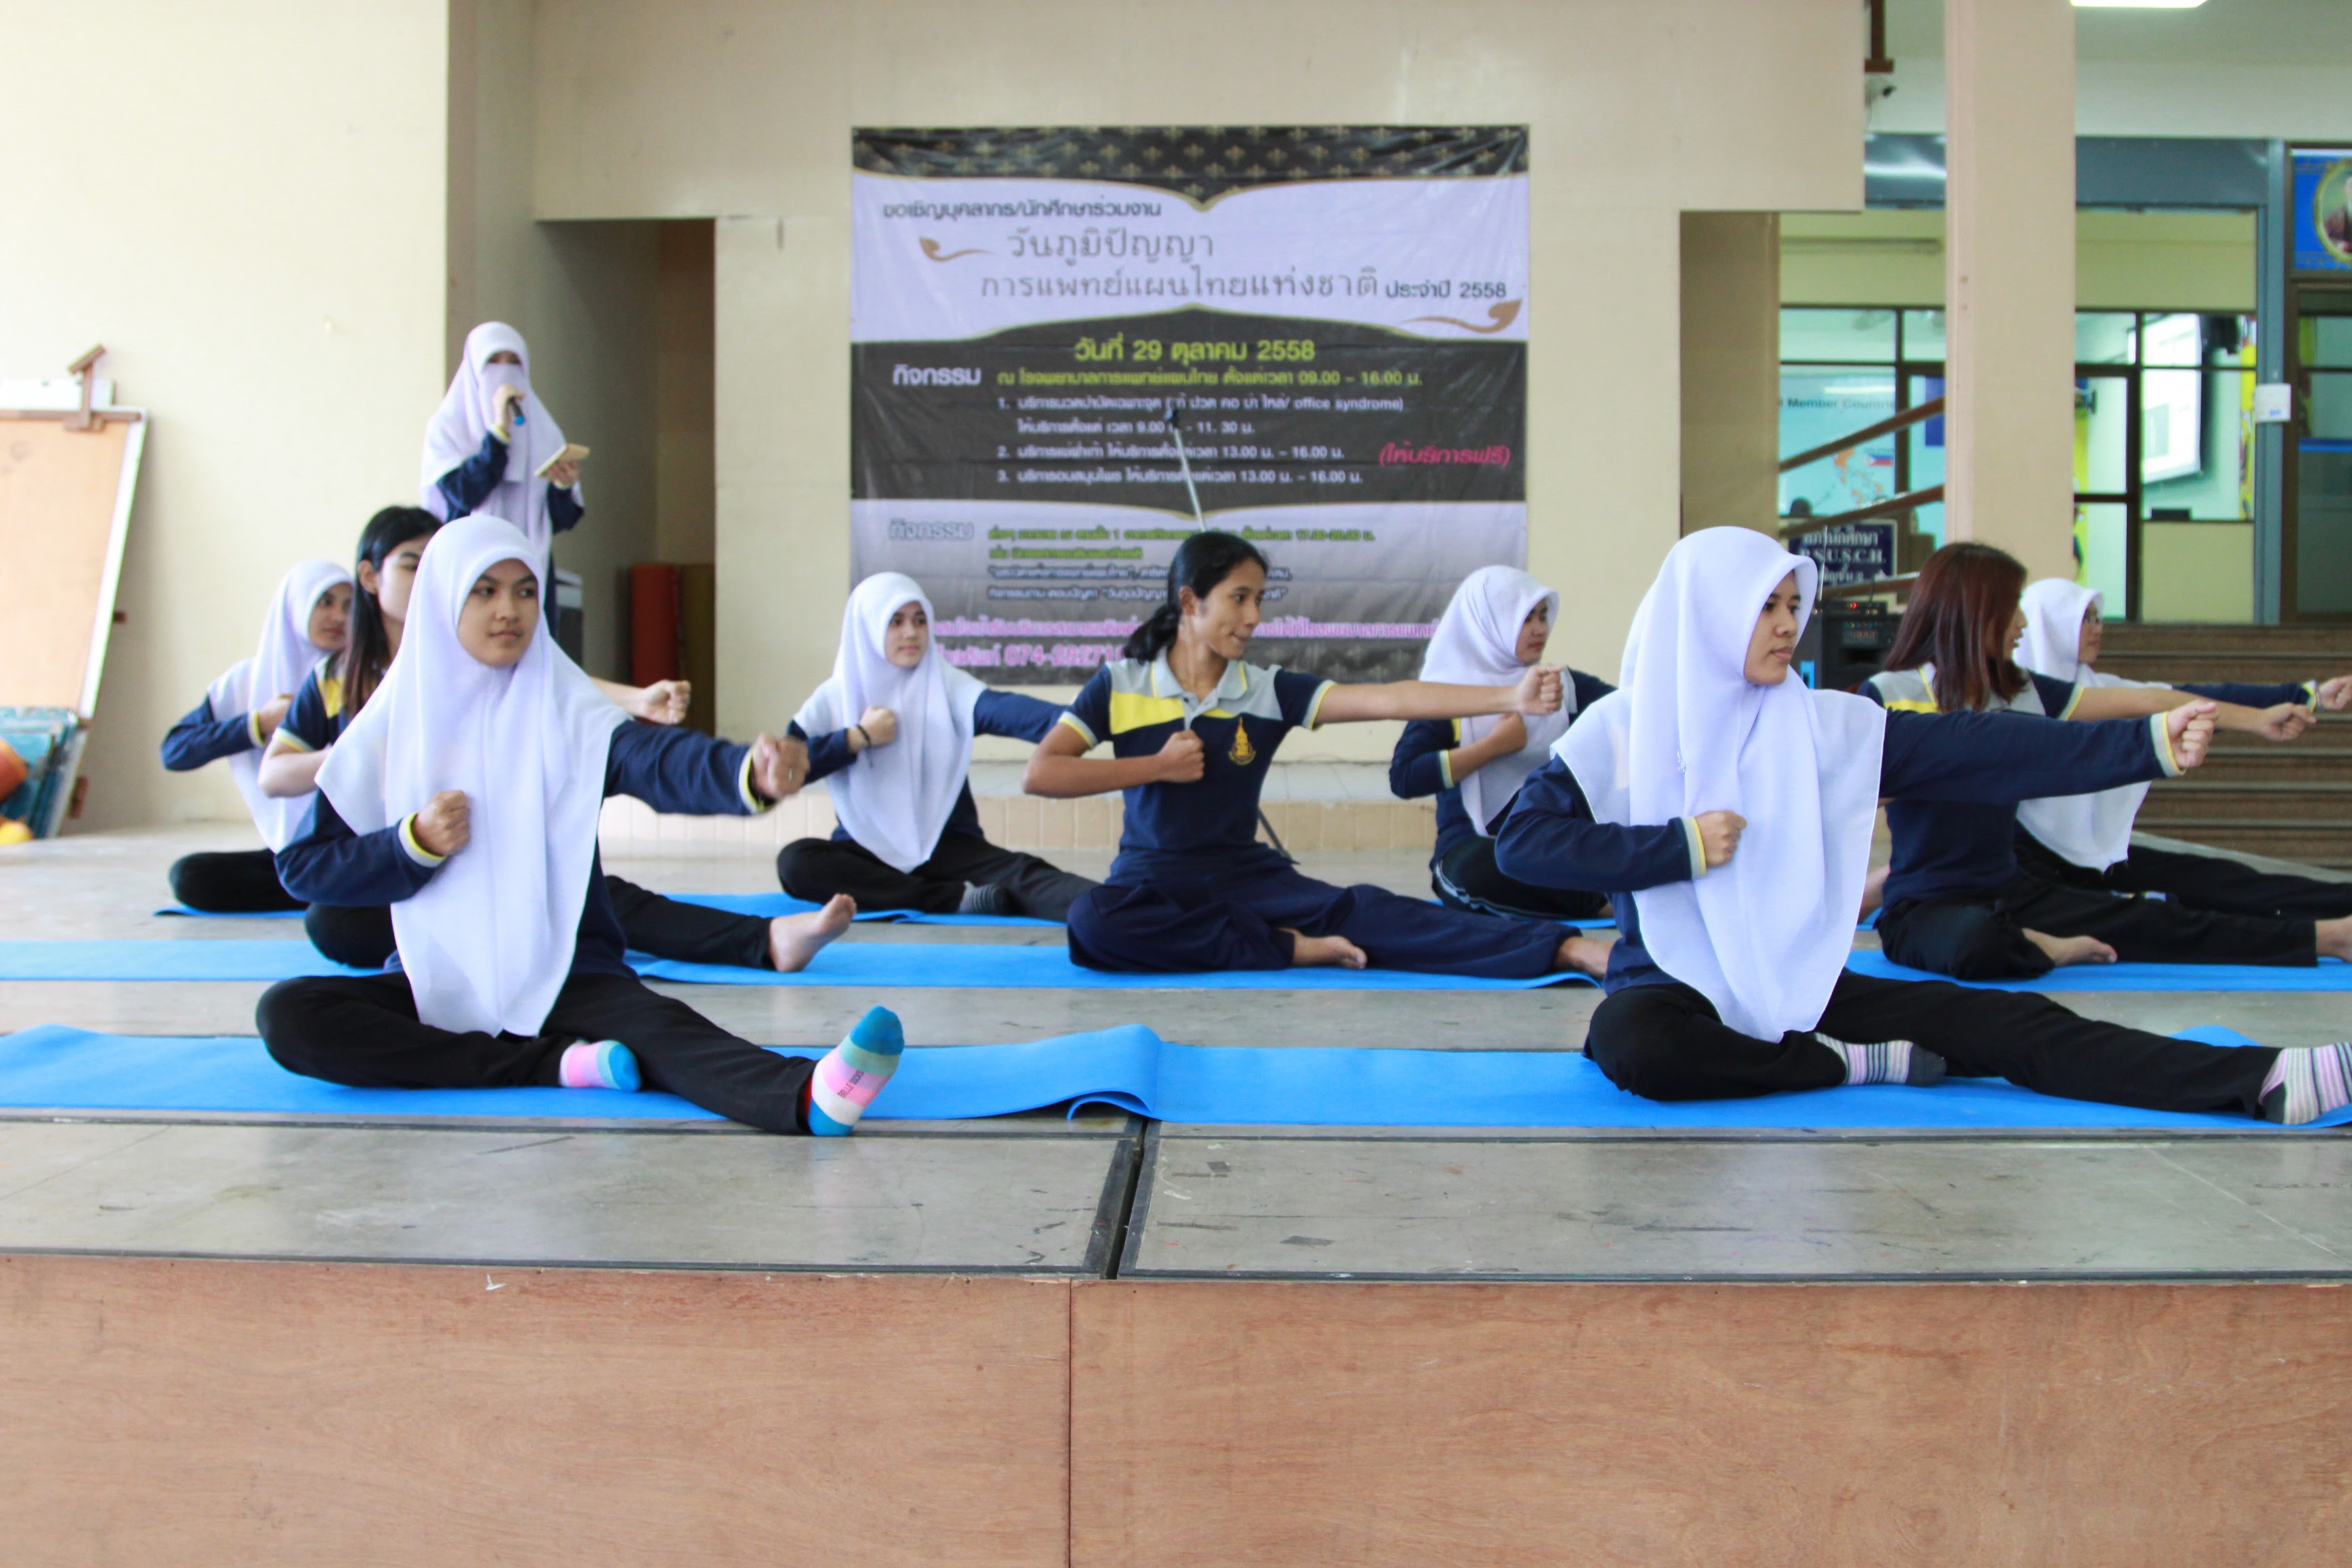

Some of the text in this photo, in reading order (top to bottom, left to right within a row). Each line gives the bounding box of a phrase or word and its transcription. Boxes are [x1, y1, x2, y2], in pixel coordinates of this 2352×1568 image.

[1007, 226, 1213, 266] วันภูมิปัญญา
[980, 263, 1507, 298] การแพทย์แผนไทยแห่งชาติ ประจำปี 2558
[1075, 332, 1316, 366] วันที่ 29 ตุลาคม 2558
[892, 364, 982, 386] กิจกรรม
[1298, 370, 1341, 386] 09.00
[1361, 370, 1403, 386] 16.00
[1294, 396, 1331, 409] office
